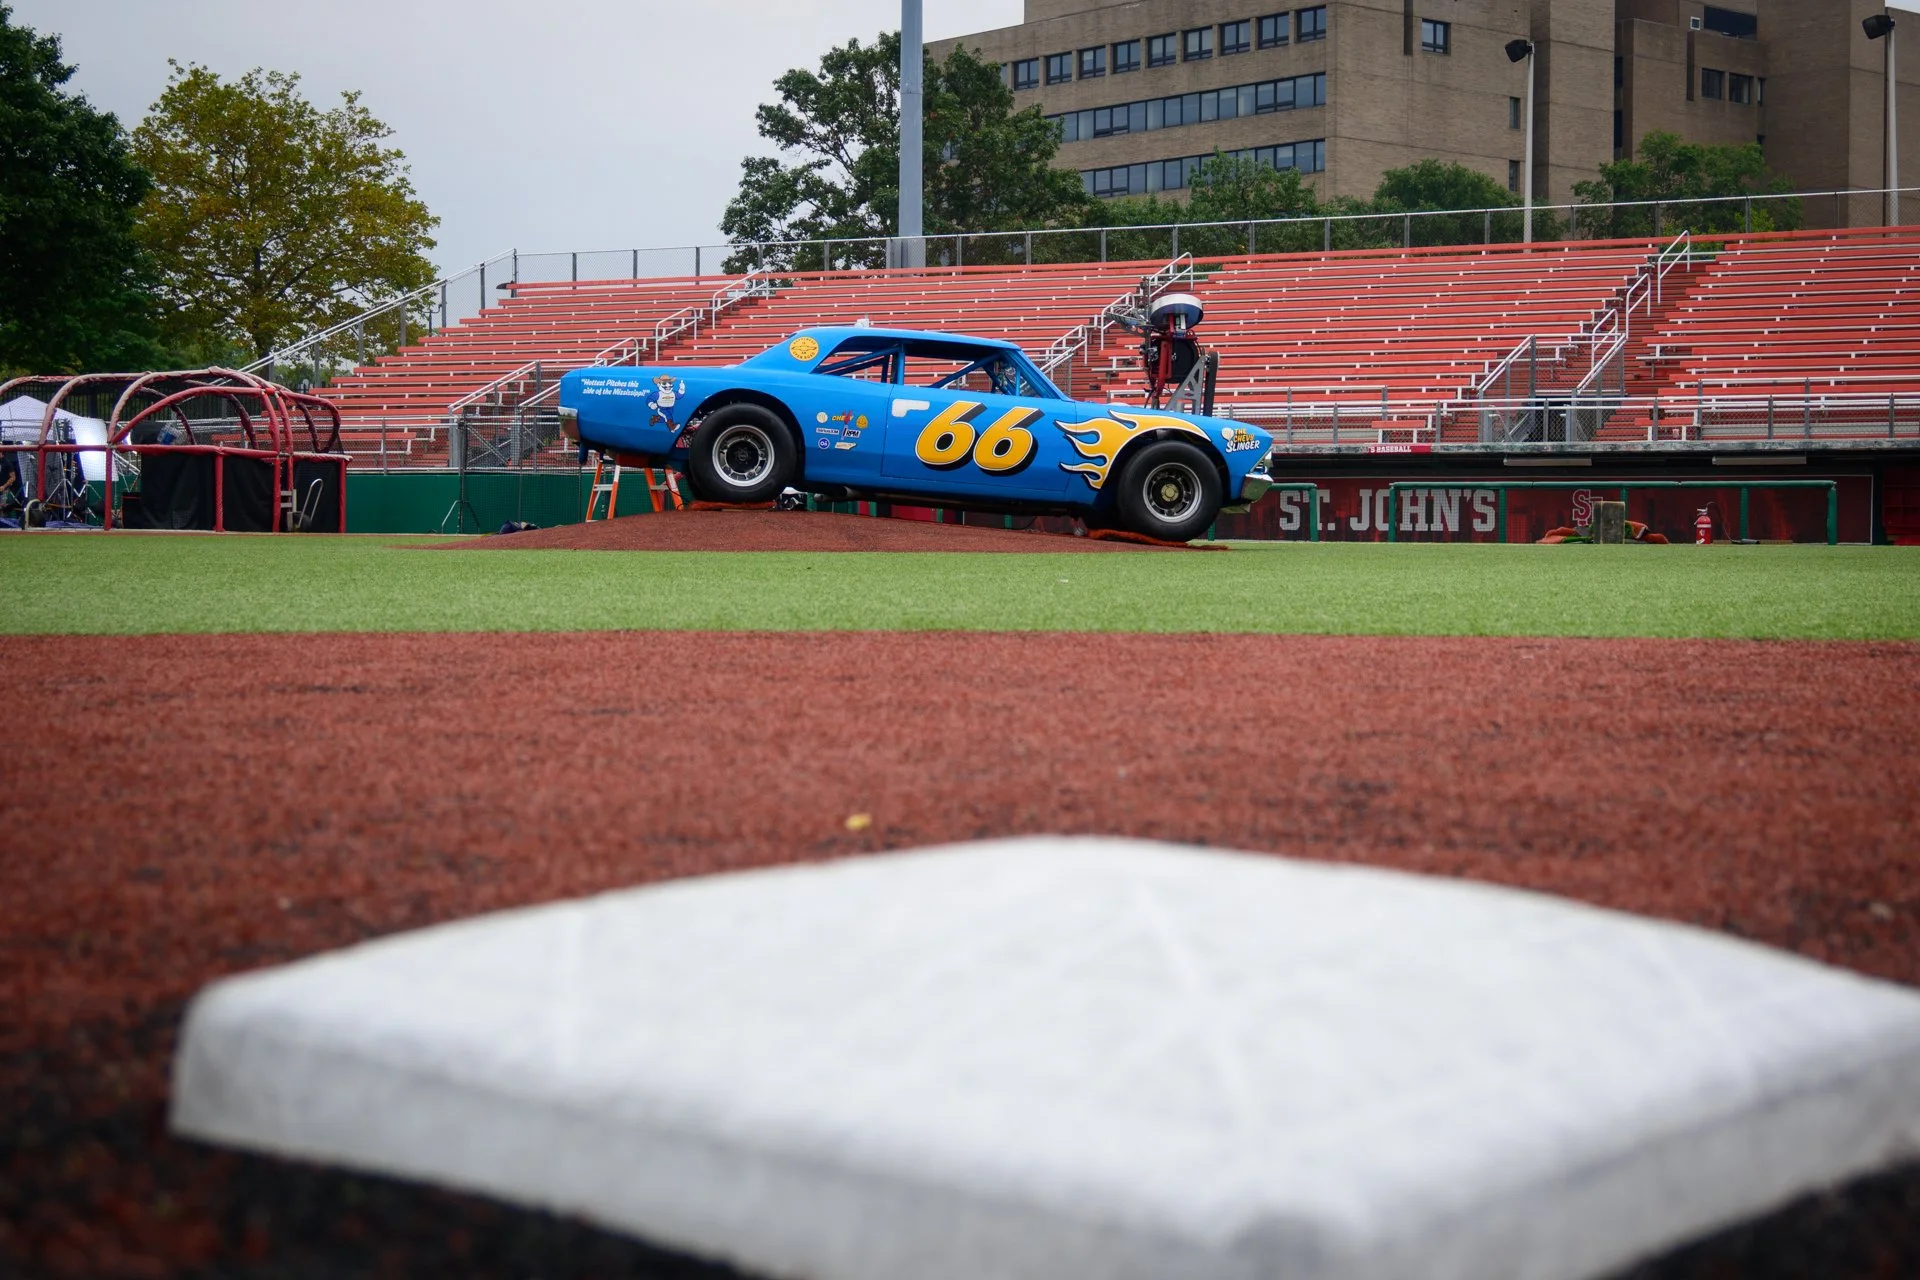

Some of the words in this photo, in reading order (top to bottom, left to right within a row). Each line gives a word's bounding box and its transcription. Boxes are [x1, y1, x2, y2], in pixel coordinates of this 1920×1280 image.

[605, 379, 627, 387] Pitches
[582, 386, 595, 394] side
[595, 387, 602, 395] of
[602, 387, 612, 395] the
[915, 400, 1044, 475] 66
[1226, 440, 1260, 453] SLINGER
[1376, 445, 1411, 453] BASEBALL
[1279, 489, 1336, 531] ST.
[1350, 489, 1496, 532] JOHN'S
